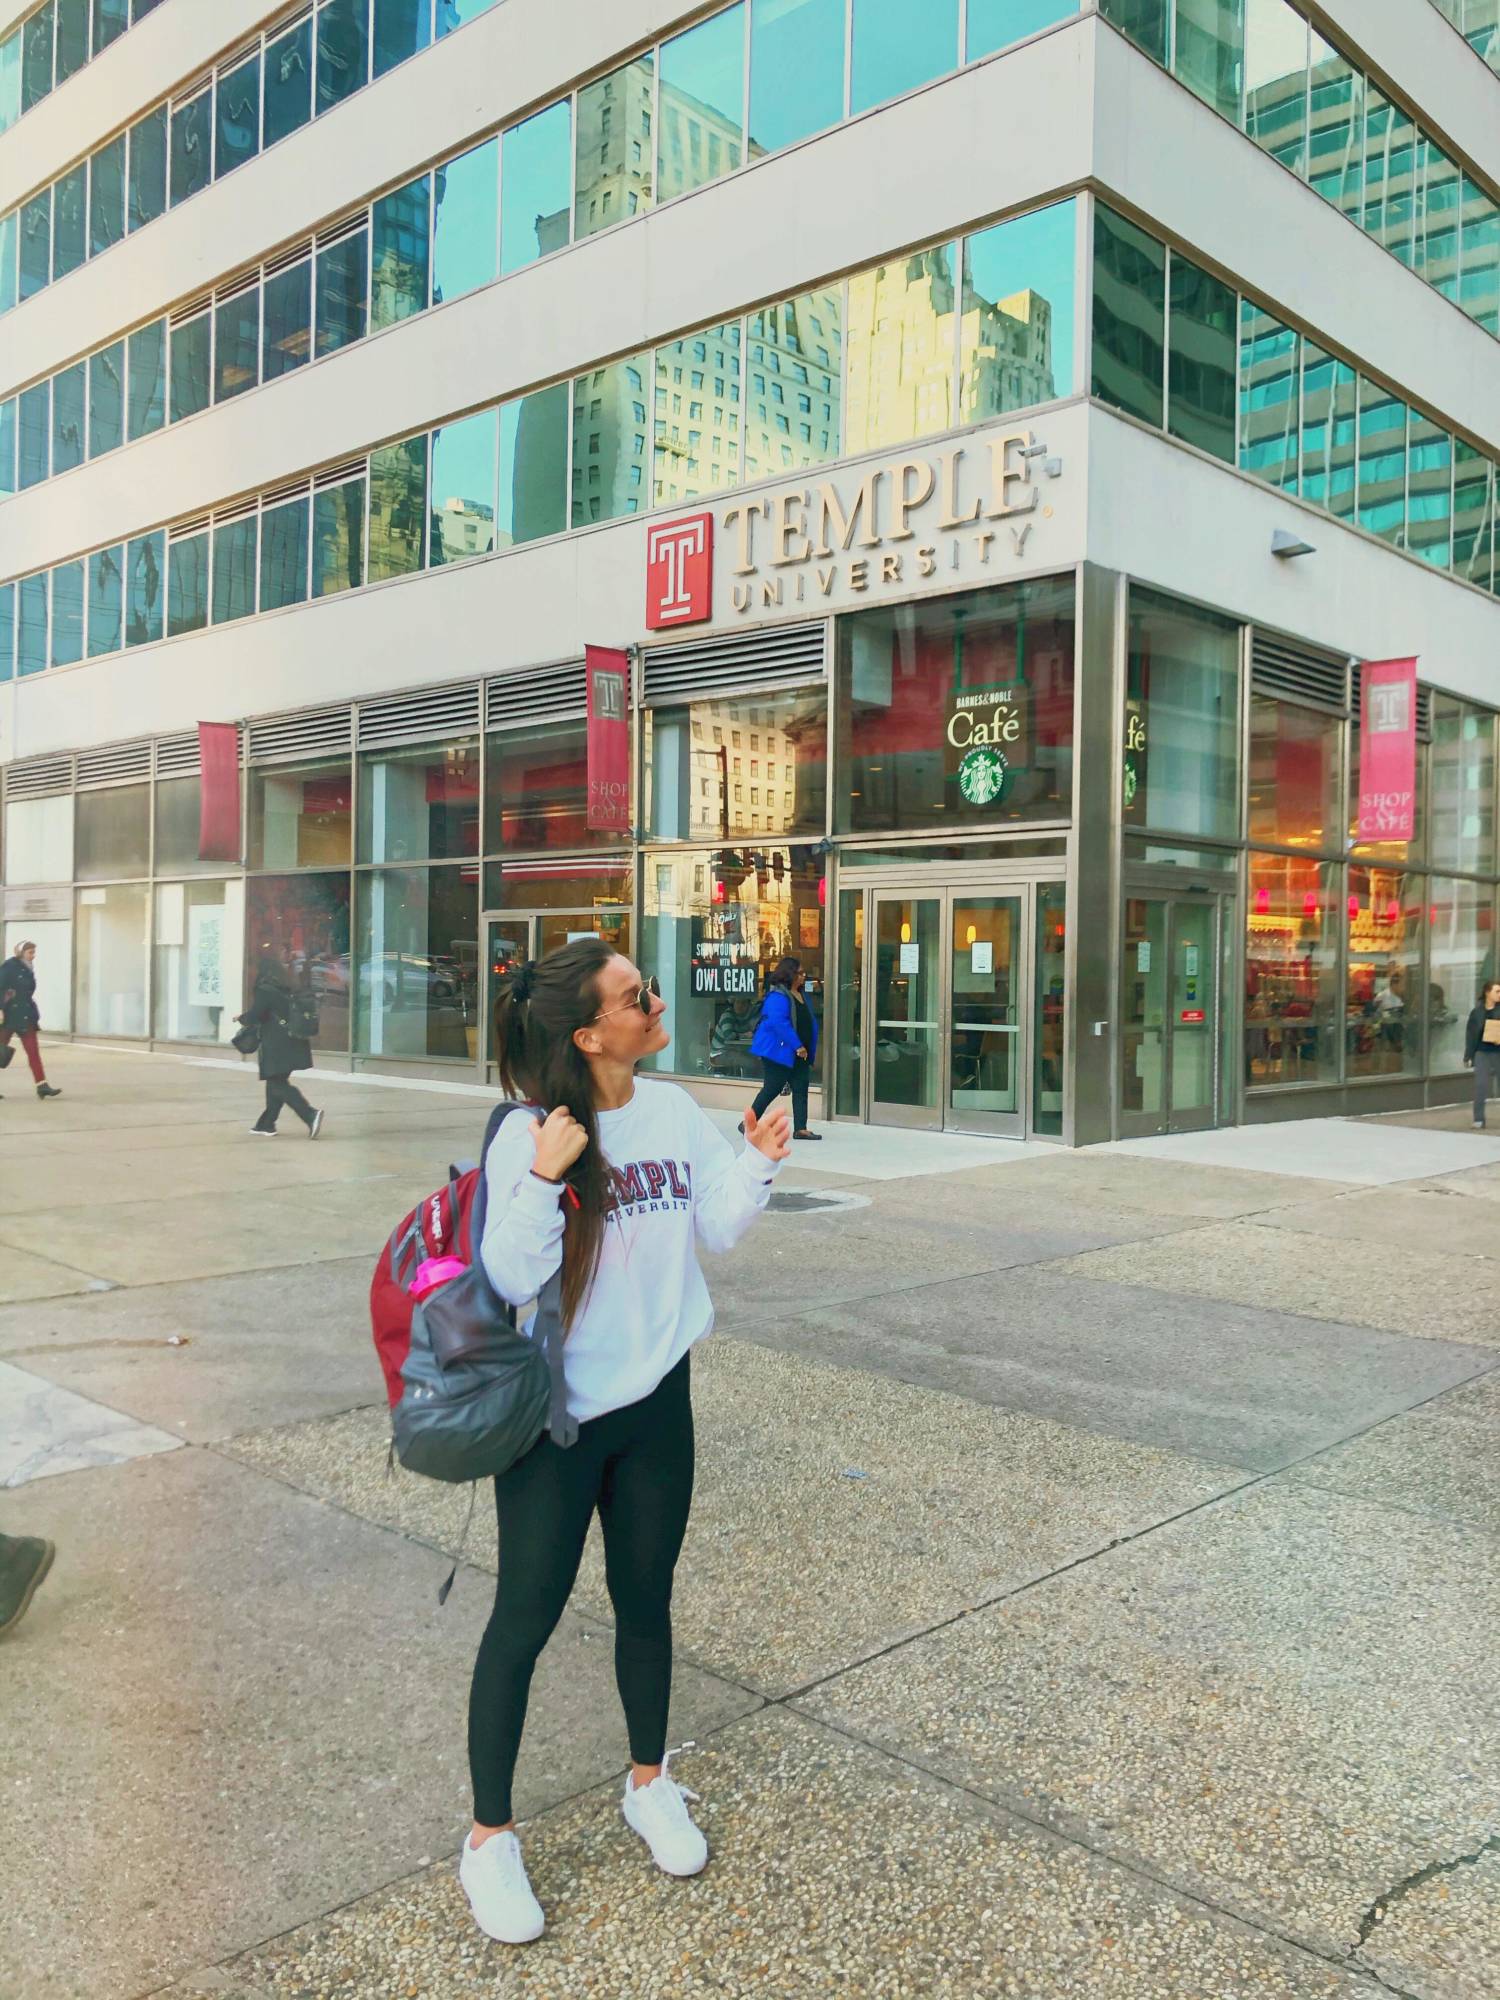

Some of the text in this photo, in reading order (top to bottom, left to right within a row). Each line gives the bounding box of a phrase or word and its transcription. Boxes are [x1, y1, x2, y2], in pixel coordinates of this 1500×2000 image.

[723, 431, 1038, 575] TEMPLE
[650, 519, 704, 619] T
[731, 523, 1033, 613] UNIVERSITY
[947, 706, 1019, 747] Café
[1125, 715, 1146, 751] fé
[1361, 792, 1411, 808] SHOP
[696, 968, 754, 992] OWL GEAR
[604, 1158, 691, 1212] MPL
[605, 1200, 688, 1222] NIVERSIT
